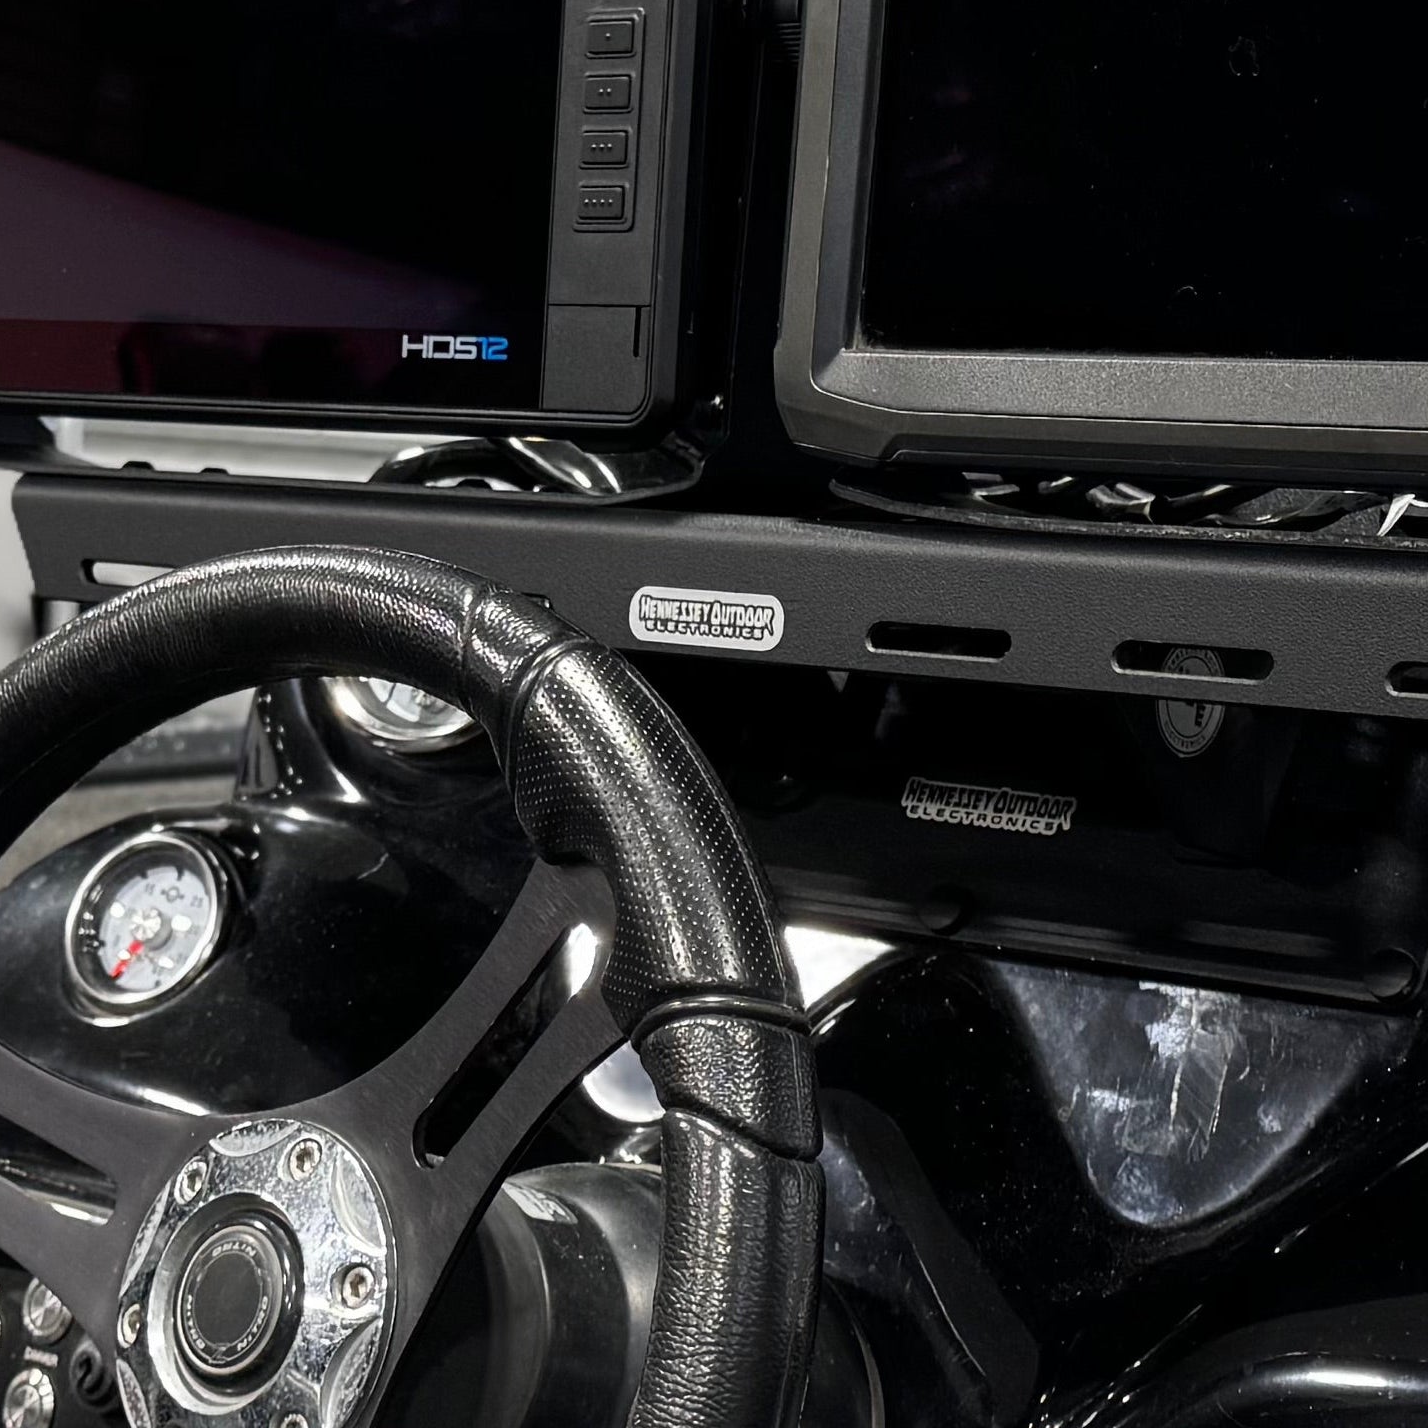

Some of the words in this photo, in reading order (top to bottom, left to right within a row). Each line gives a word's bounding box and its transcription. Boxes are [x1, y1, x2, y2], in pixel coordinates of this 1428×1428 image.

[639, 595, 712, 622] HENNESSEY
[710, 600, 774, 636] OUTDOOR
[645, 620, 765, 641] ELECTRONICS
[902, 777, 996, 809] HENNESSEY
[993, 788, 1076, 830] OUTDOOR
[907, 804, 1059, 835] ELECTRONICS
